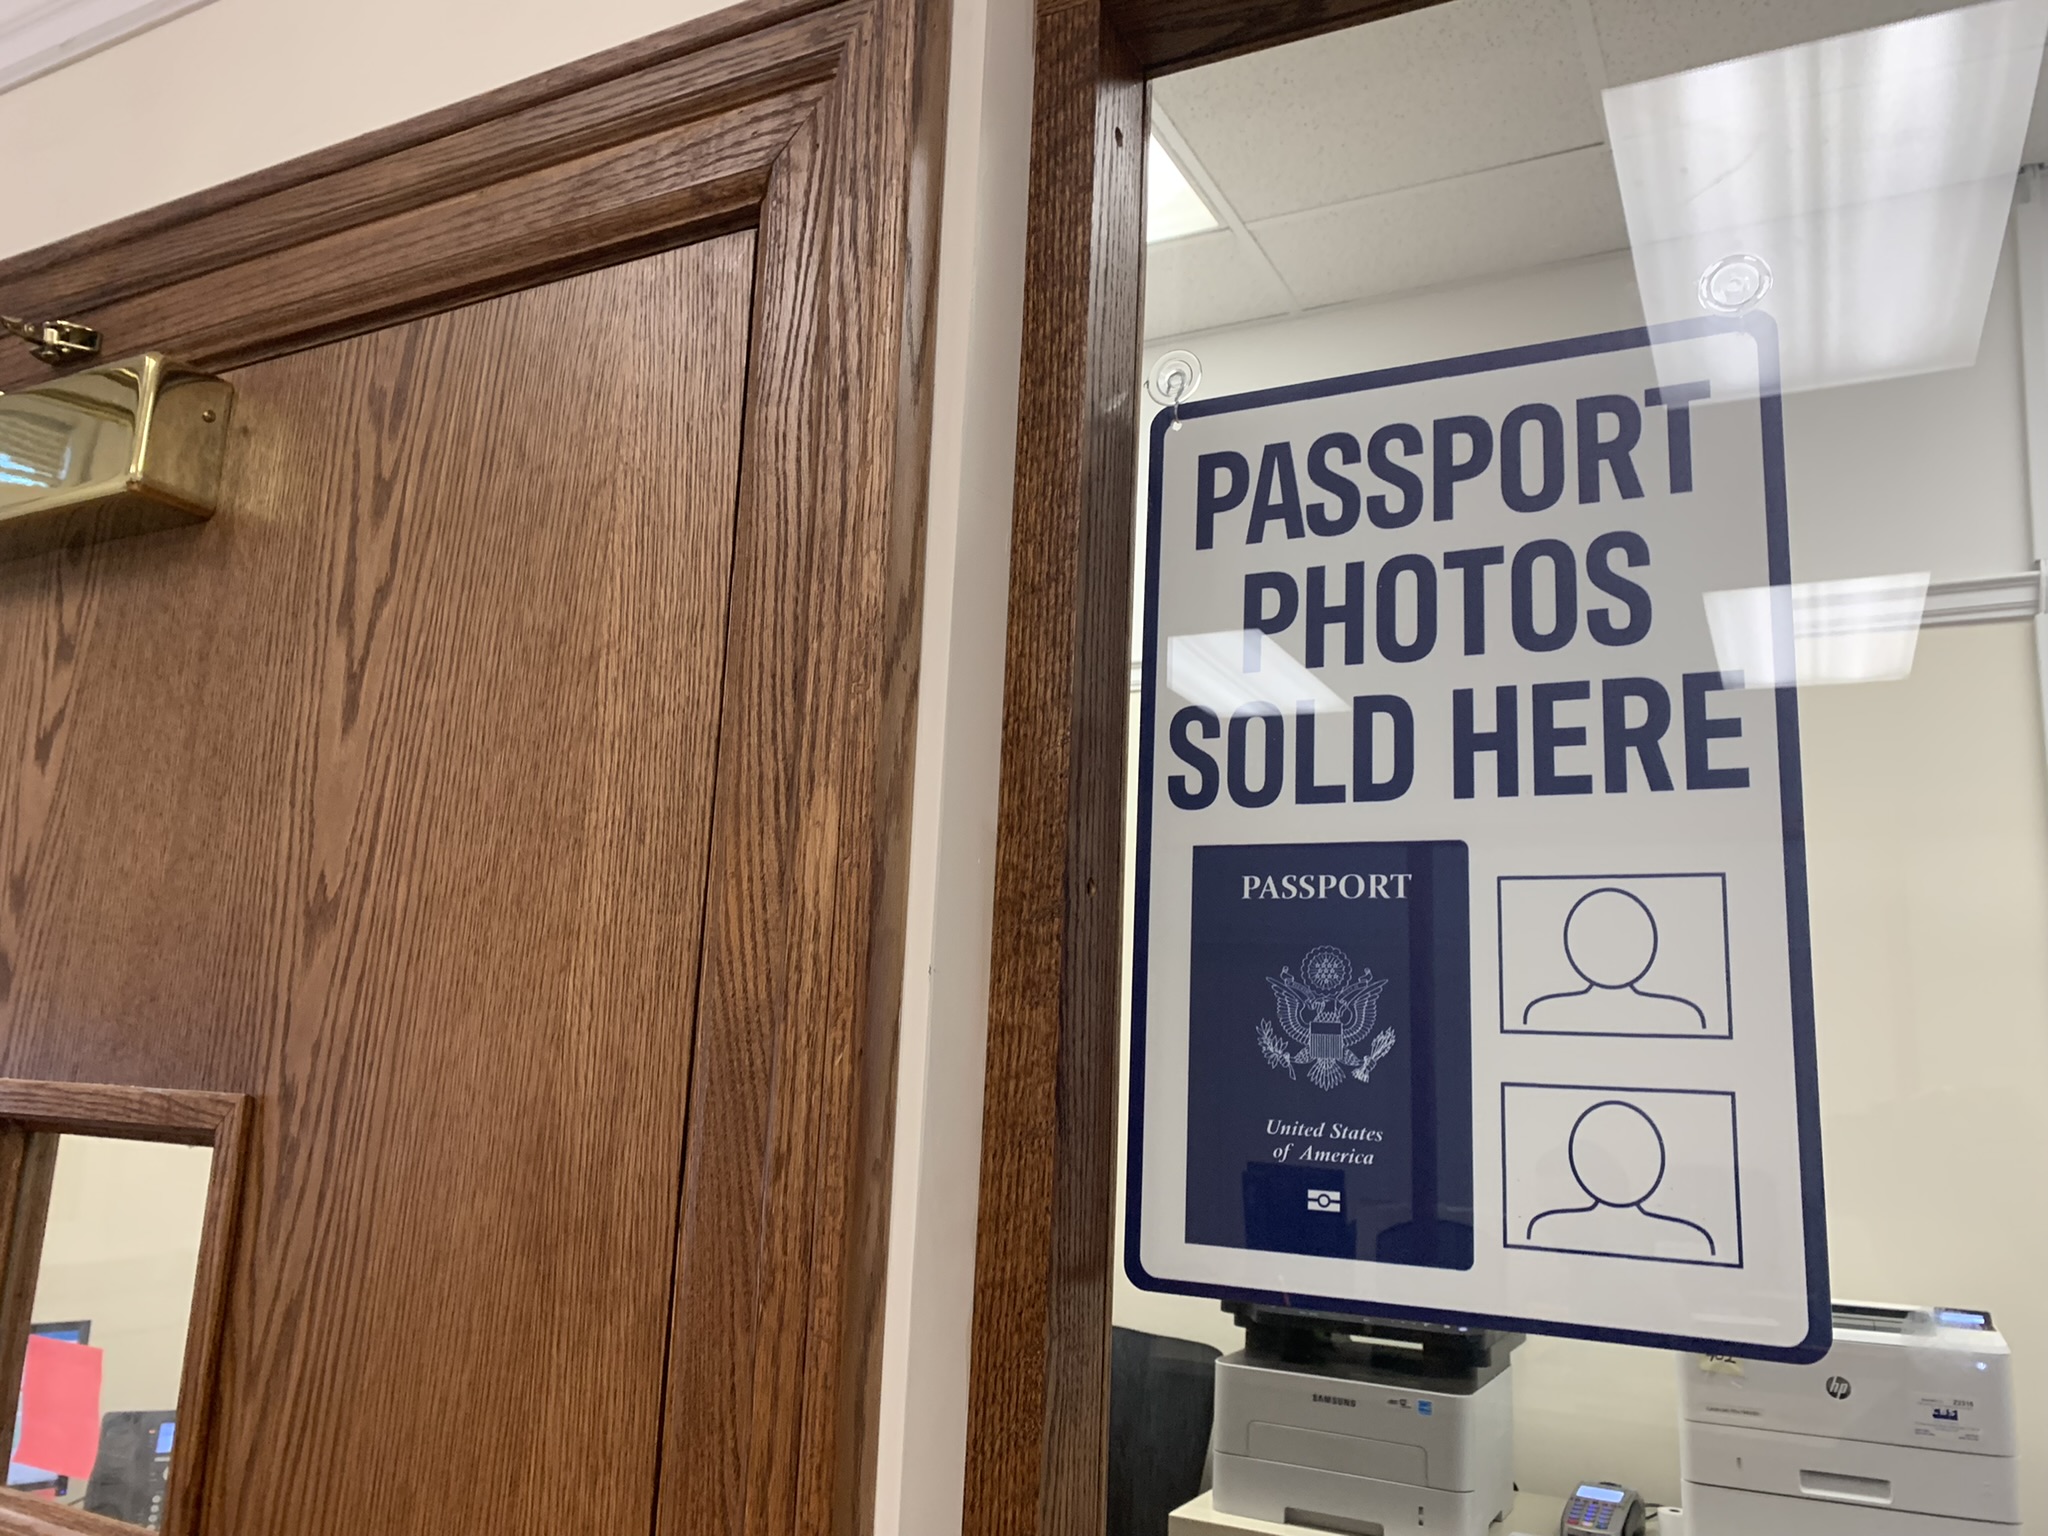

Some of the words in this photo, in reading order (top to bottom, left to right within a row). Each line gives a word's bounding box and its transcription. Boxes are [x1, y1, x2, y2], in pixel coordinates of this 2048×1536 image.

[1195, 380, 1711, 551] PASSPORT
[1242, 530, 1652, 674] PHOTOS
[1167, 693, 1415, 811] SOLD
[1452, 669, 1751, 800] HERE
[1241, 873, 1412, 900] PASSPORT
[1266, 1119, 1326, 1137] United
[1329, 1122, 1384, 1142] States
[1272, 1142, 1294, 1163] of
[1298, 1144, 1374, 1165] America
[1312, 1393, 1357, 1408] SAMSUNG
[1829, 1376, 1849, 1400] hp
